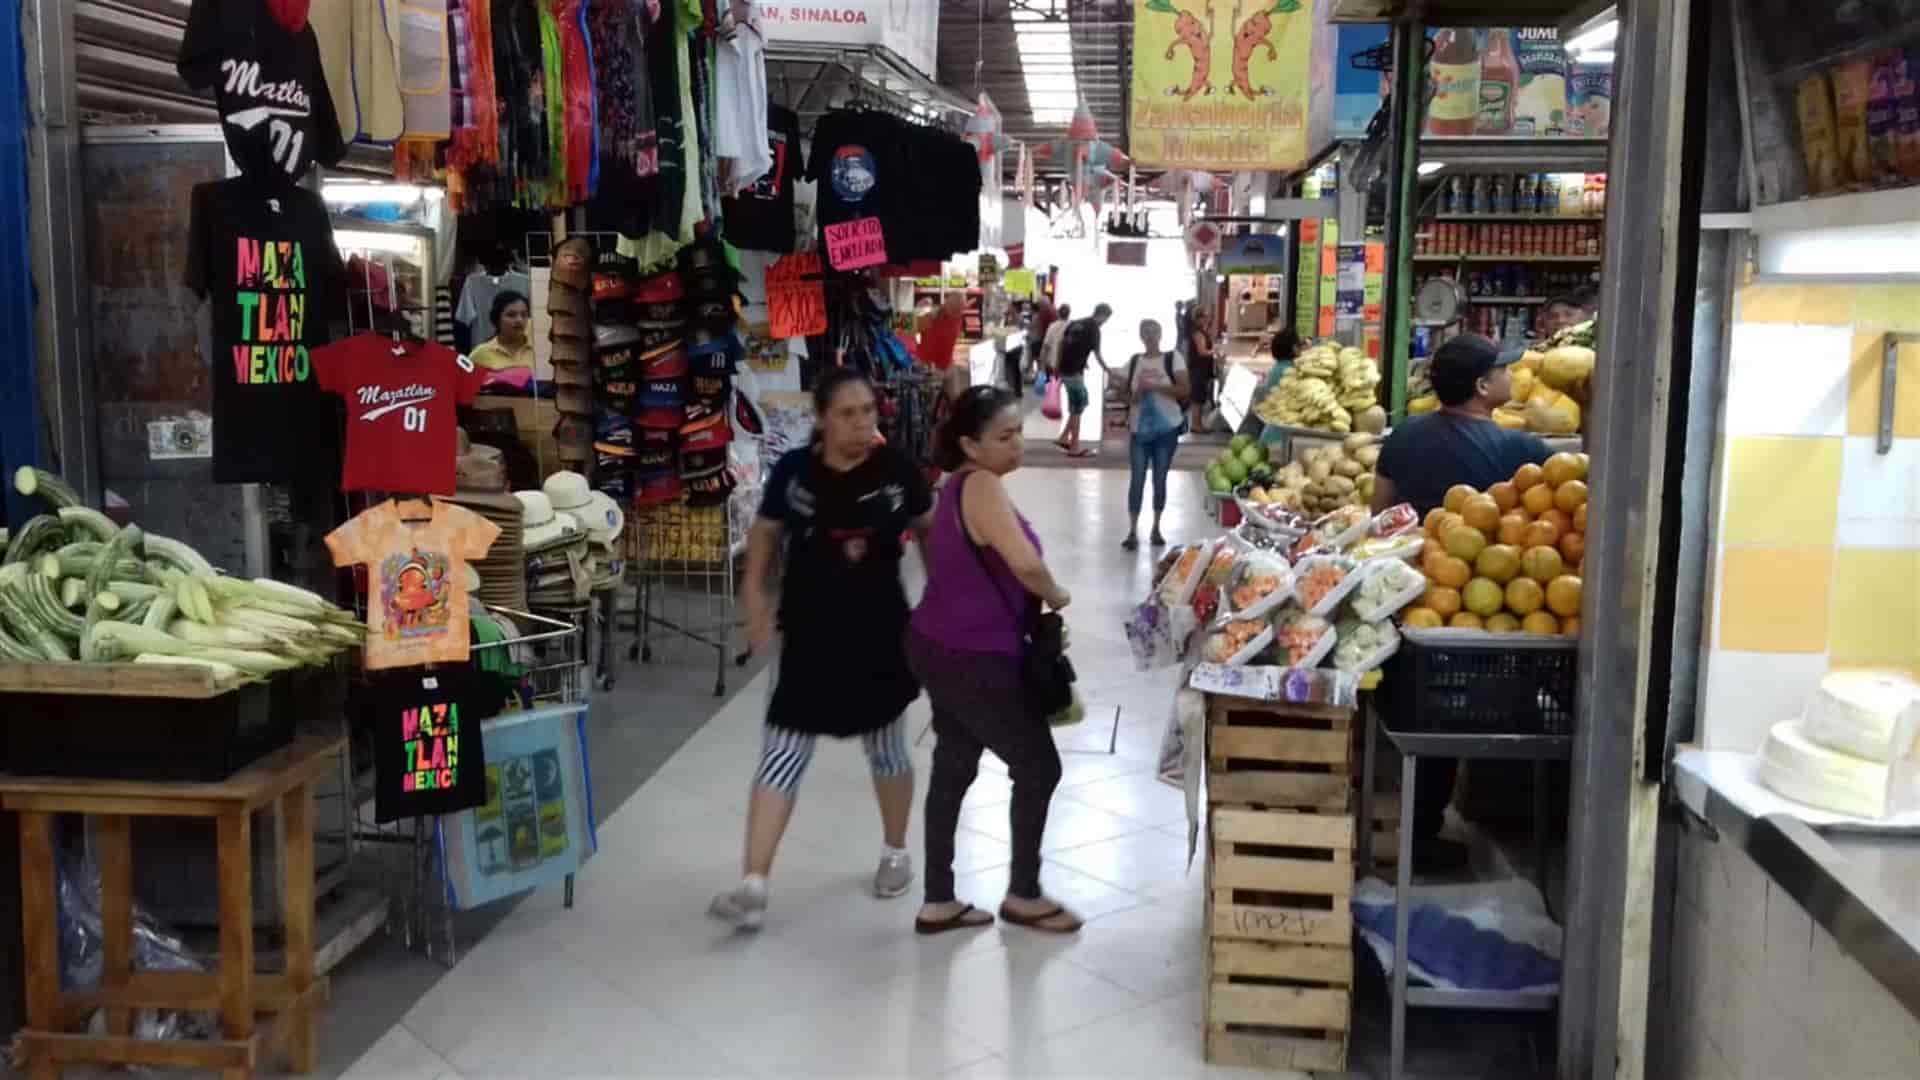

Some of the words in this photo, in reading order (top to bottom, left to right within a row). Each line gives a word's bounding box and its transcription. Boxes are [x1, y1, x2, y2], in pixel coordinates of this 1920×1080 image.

[791, 8, 867, 24] SINALOA
[237, 237, 306, 289] MAZA
[236, 291, 304, 341] TLAN
[232, 344, 309, 384] MEXICO
[356, 384, 436, 405] Mazatlán
[403, 406, 427, 433] 01
[402, 703, 459, 740] MAZA
[404, 735, 459, 771] TLAN
